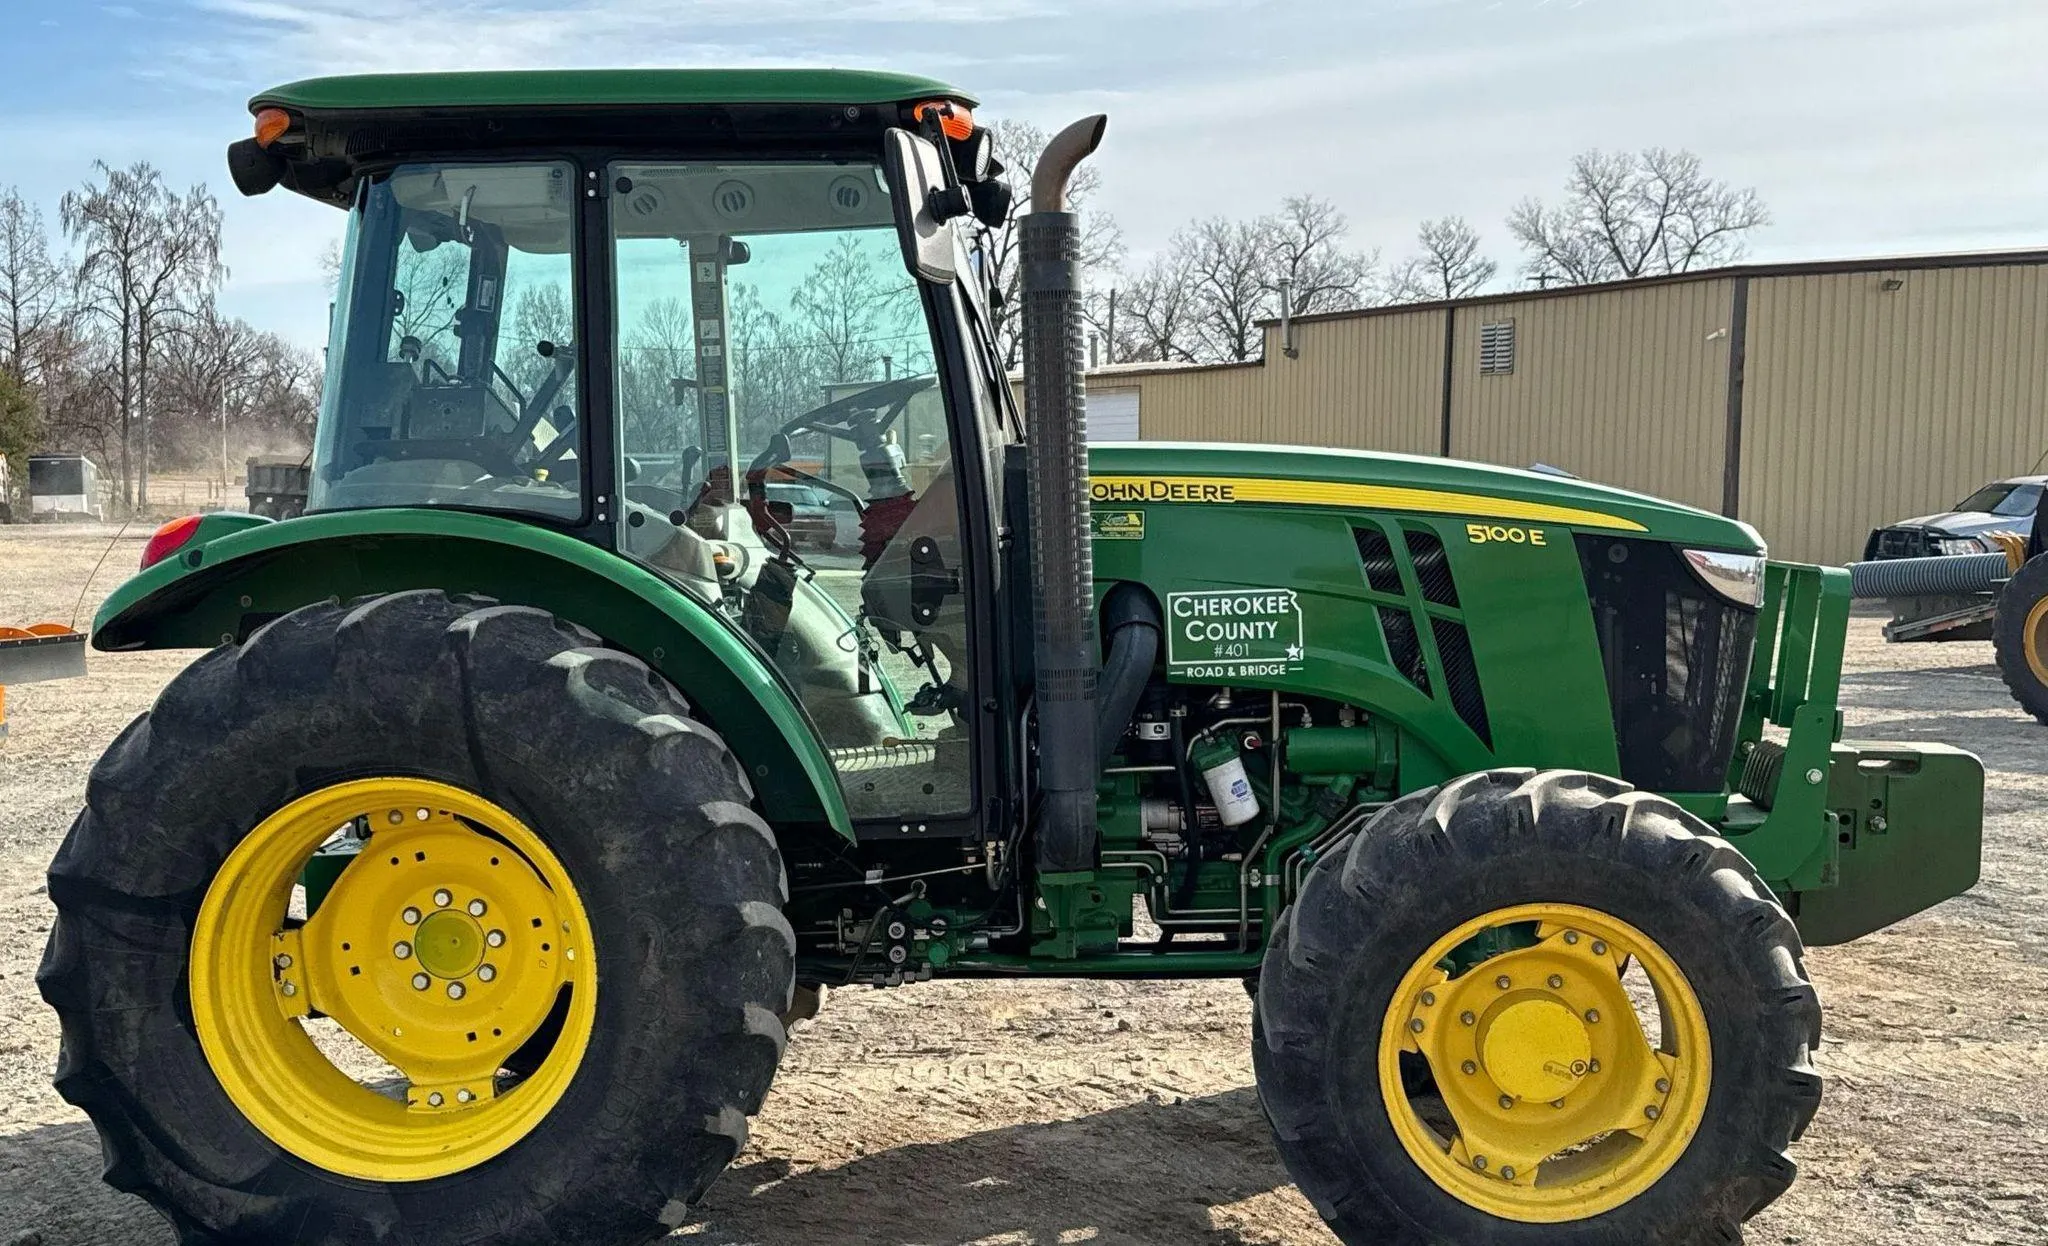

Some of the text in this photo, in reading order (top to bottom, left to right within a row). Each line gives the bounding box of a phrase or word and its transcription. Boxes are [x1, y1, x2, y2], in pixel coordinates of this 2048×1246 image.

[1091, 481, 1235, 500] OHN DEERE
[1466, 524, 1547, 546] 5100 E
[1174, 596, 1289, 617] CHEROKEE
[1185, 620, 1278, 641] COUNTY
[1214, 643, 1249, 657] #401
[1187, 665, 1286, 677] ROAD & BRIDGE
